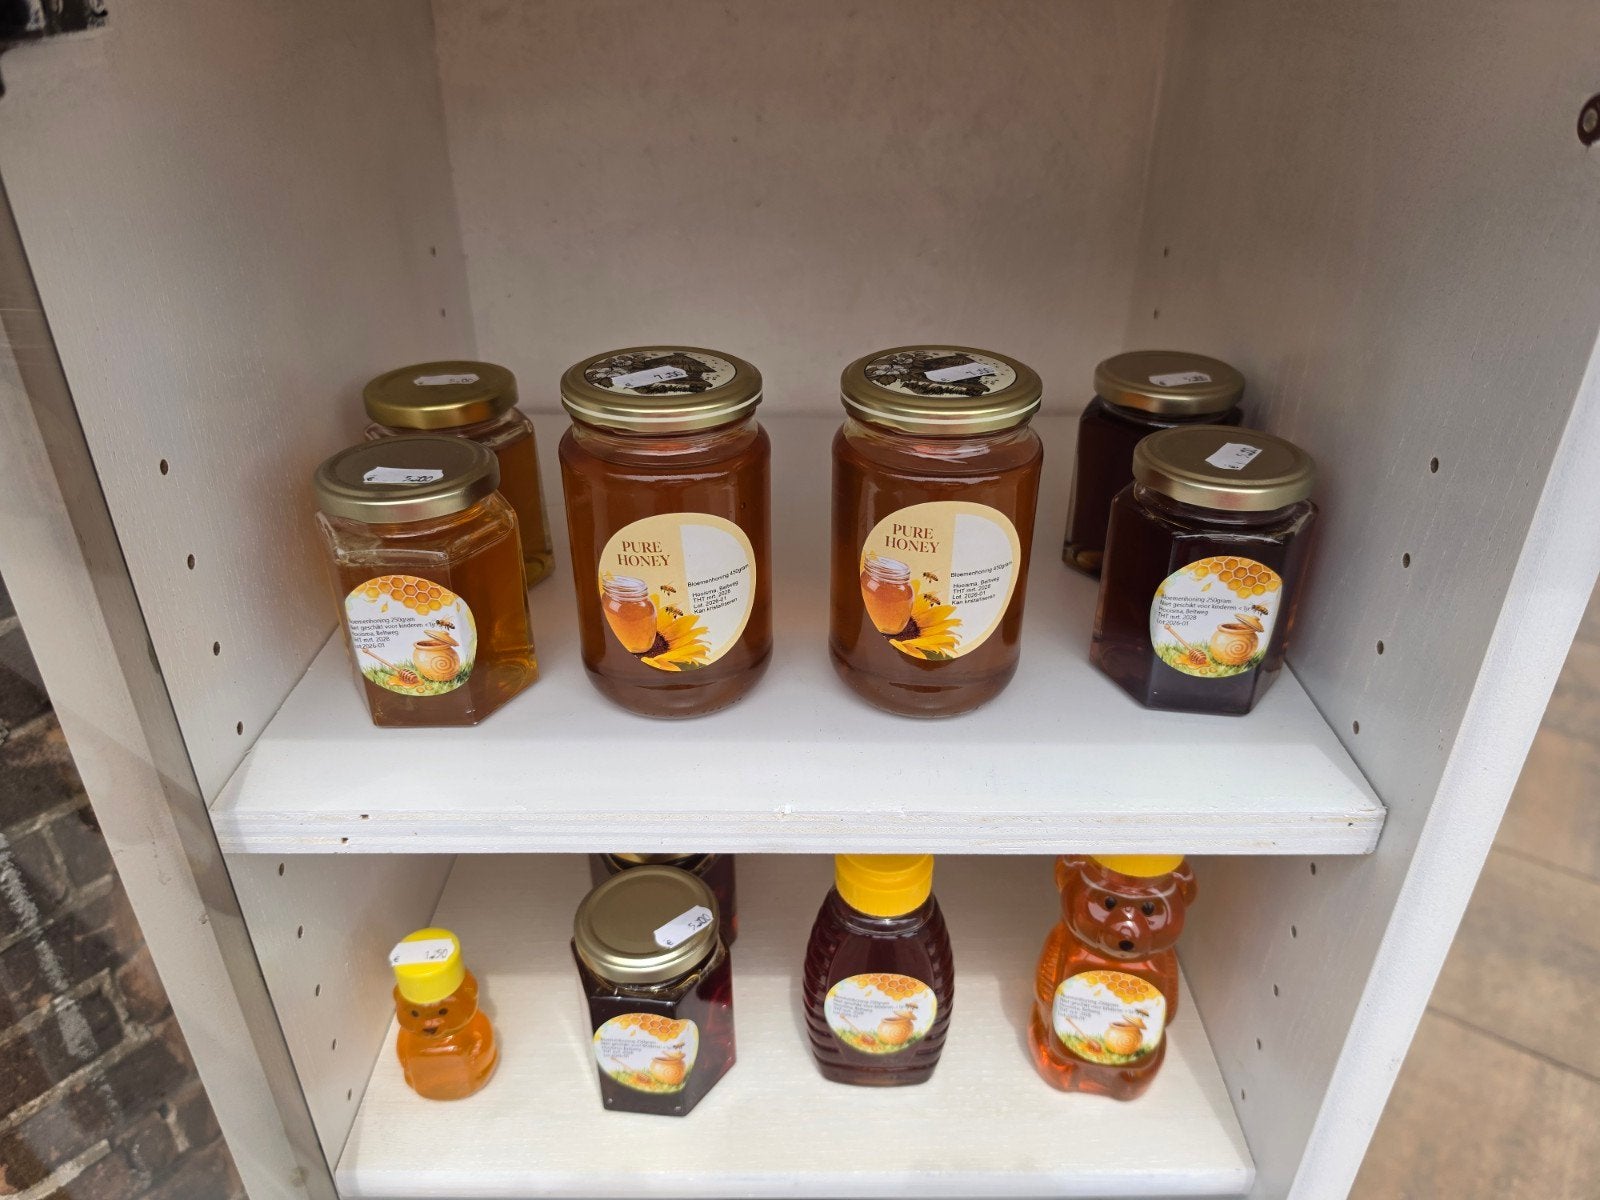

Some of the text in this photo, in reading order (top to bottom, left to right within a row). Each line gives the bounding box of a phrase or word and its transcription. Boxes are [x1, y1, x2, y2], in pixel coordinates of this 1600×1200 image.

[893, 524, 934, 539] PURE
[622, 541, 662, 553] PURE
[885, 536, 940, 553] HONEY
[617, 554, 670, 566] HONEY
[951, 568, 993, 577] Bloemenhoning
[688, 573, 729, 587] Bloemenhoning
[361, 623, 384, 632] geschikt
